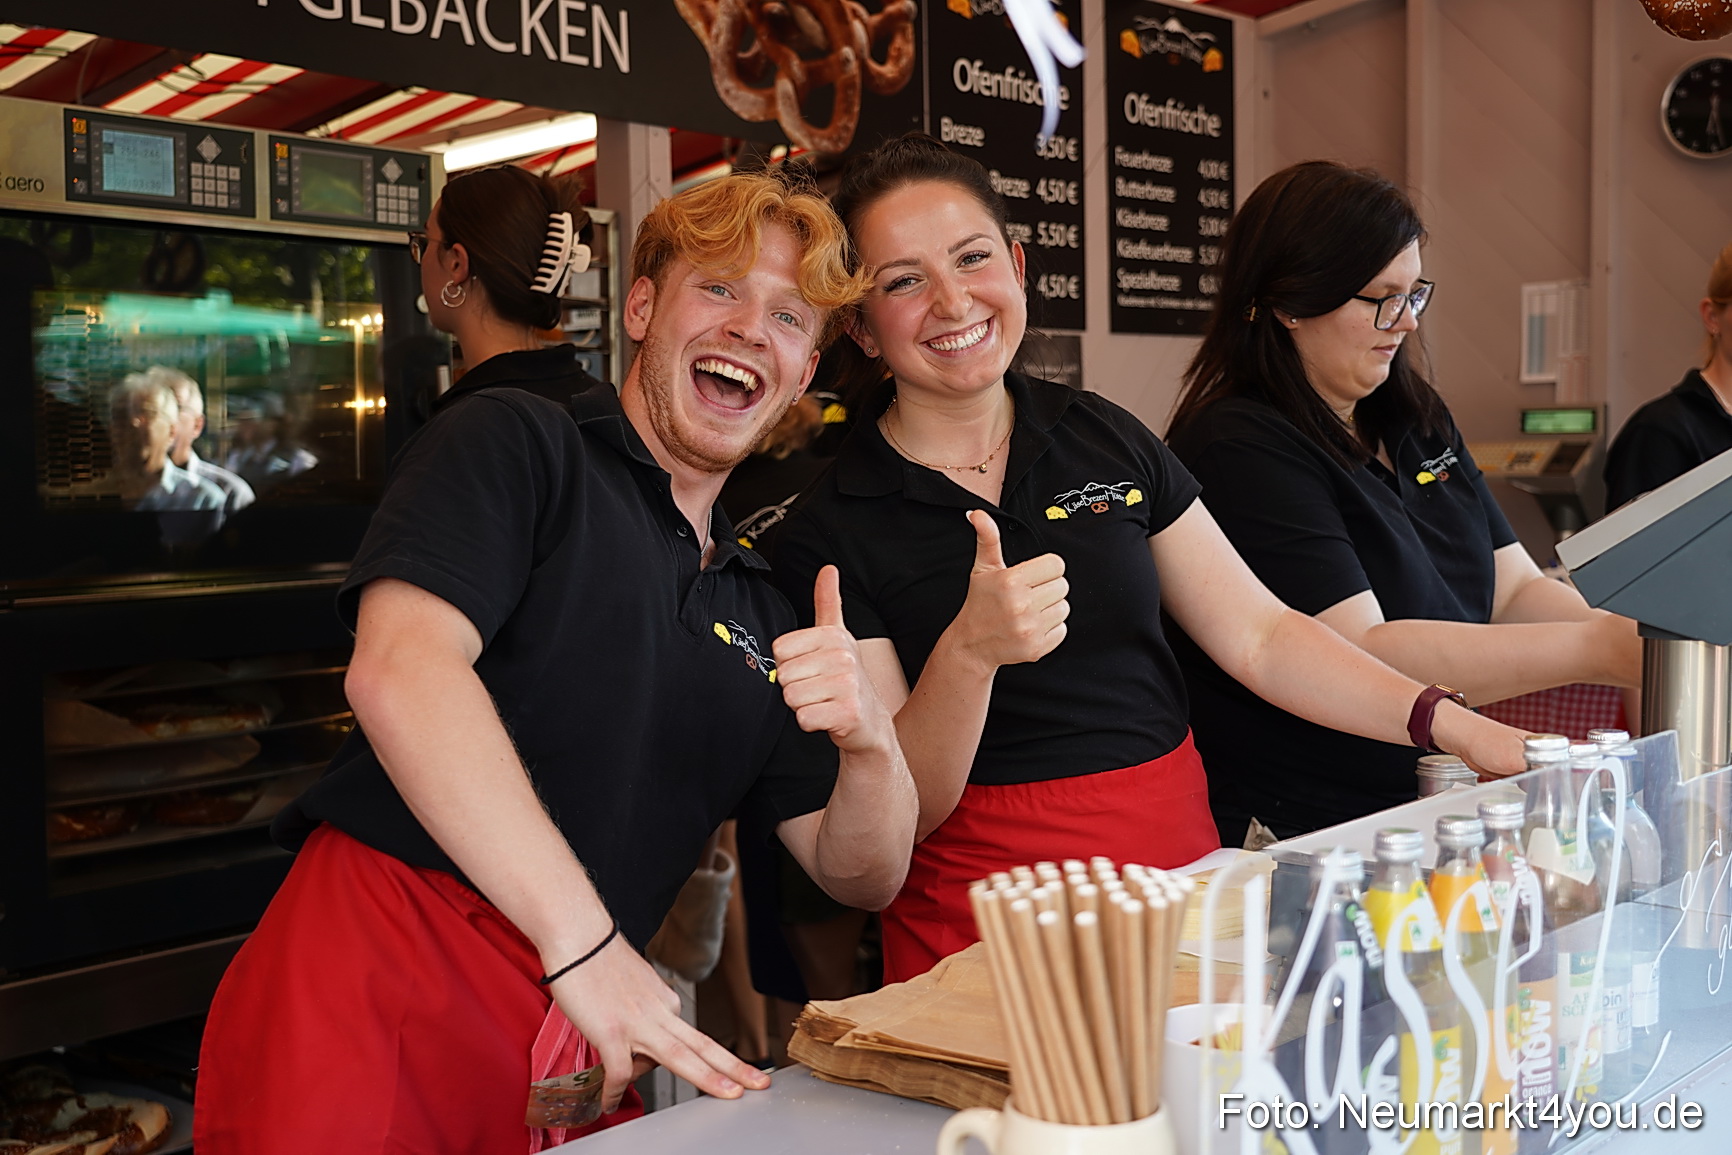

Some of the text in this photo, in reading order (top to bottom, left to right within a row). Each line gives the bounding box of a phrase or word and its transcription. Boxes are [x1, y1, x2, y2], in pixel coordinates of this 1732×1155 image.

[300, 0, 630, 73] BACKEN
[953, 57, 1070, 111] Ofenfrisce
[940, 116, 985, 147] Breze
[1124, 91, 1222, 138] Ofenfrische
[5, 176, 45, 193] aero
